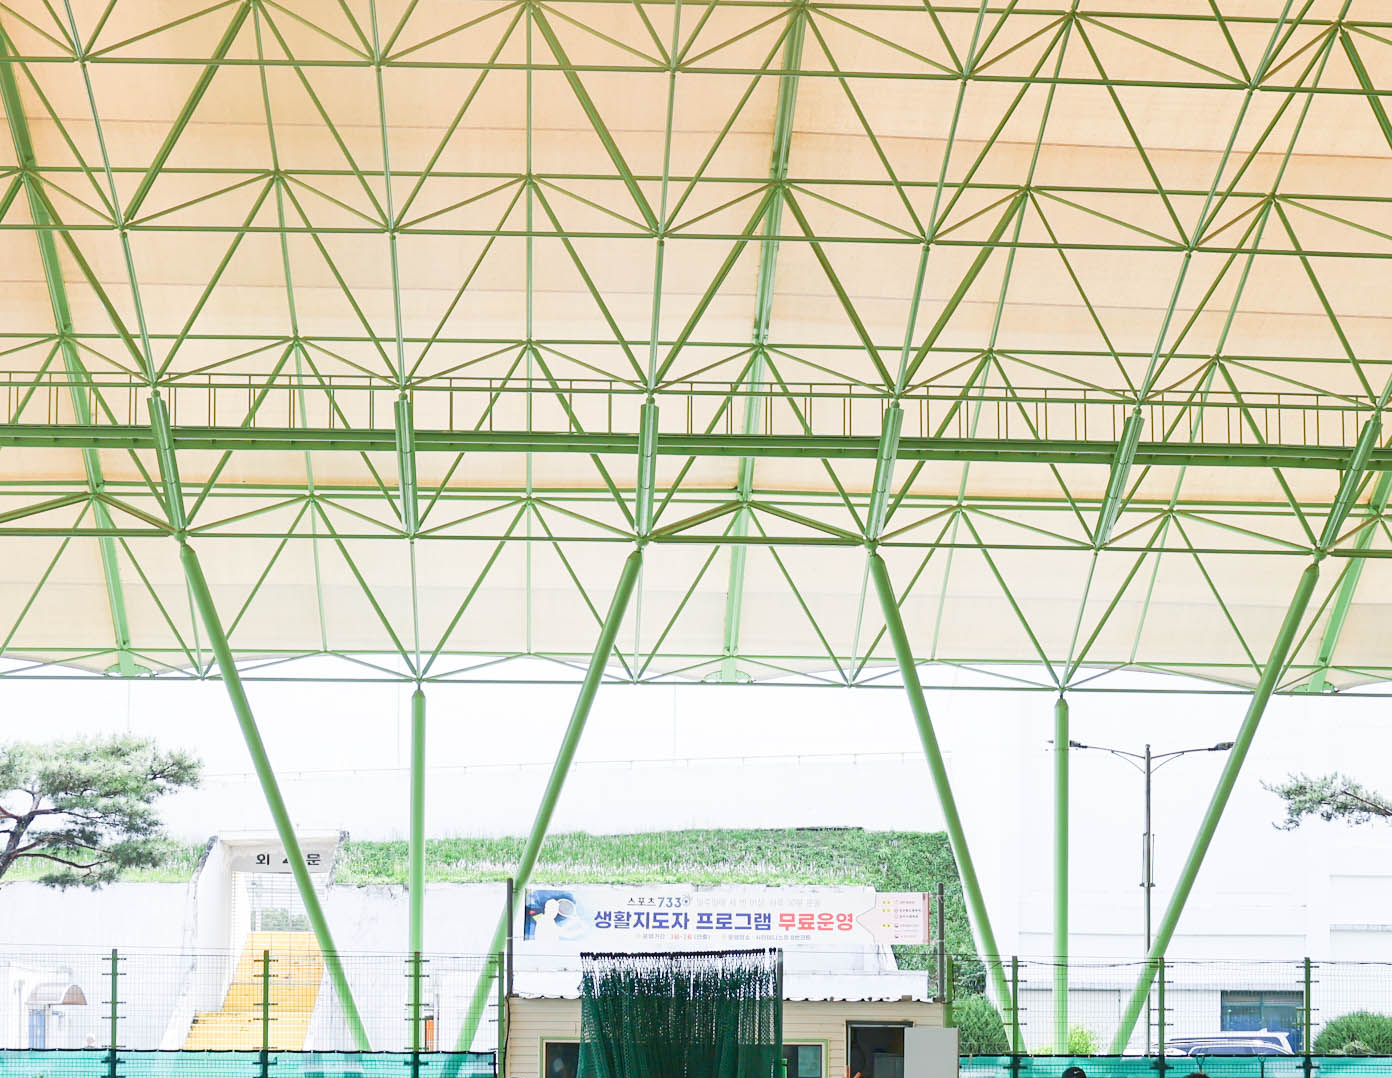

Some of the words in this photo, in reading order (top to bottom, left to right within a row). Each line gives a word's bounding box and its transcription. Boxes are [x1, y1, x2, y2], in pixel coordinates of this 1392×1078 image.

[594, 911, 690, 930] 생활지도자
[696, 912, 771, 931] 프로그램
[778, 912, 853, 931] 무료운영
